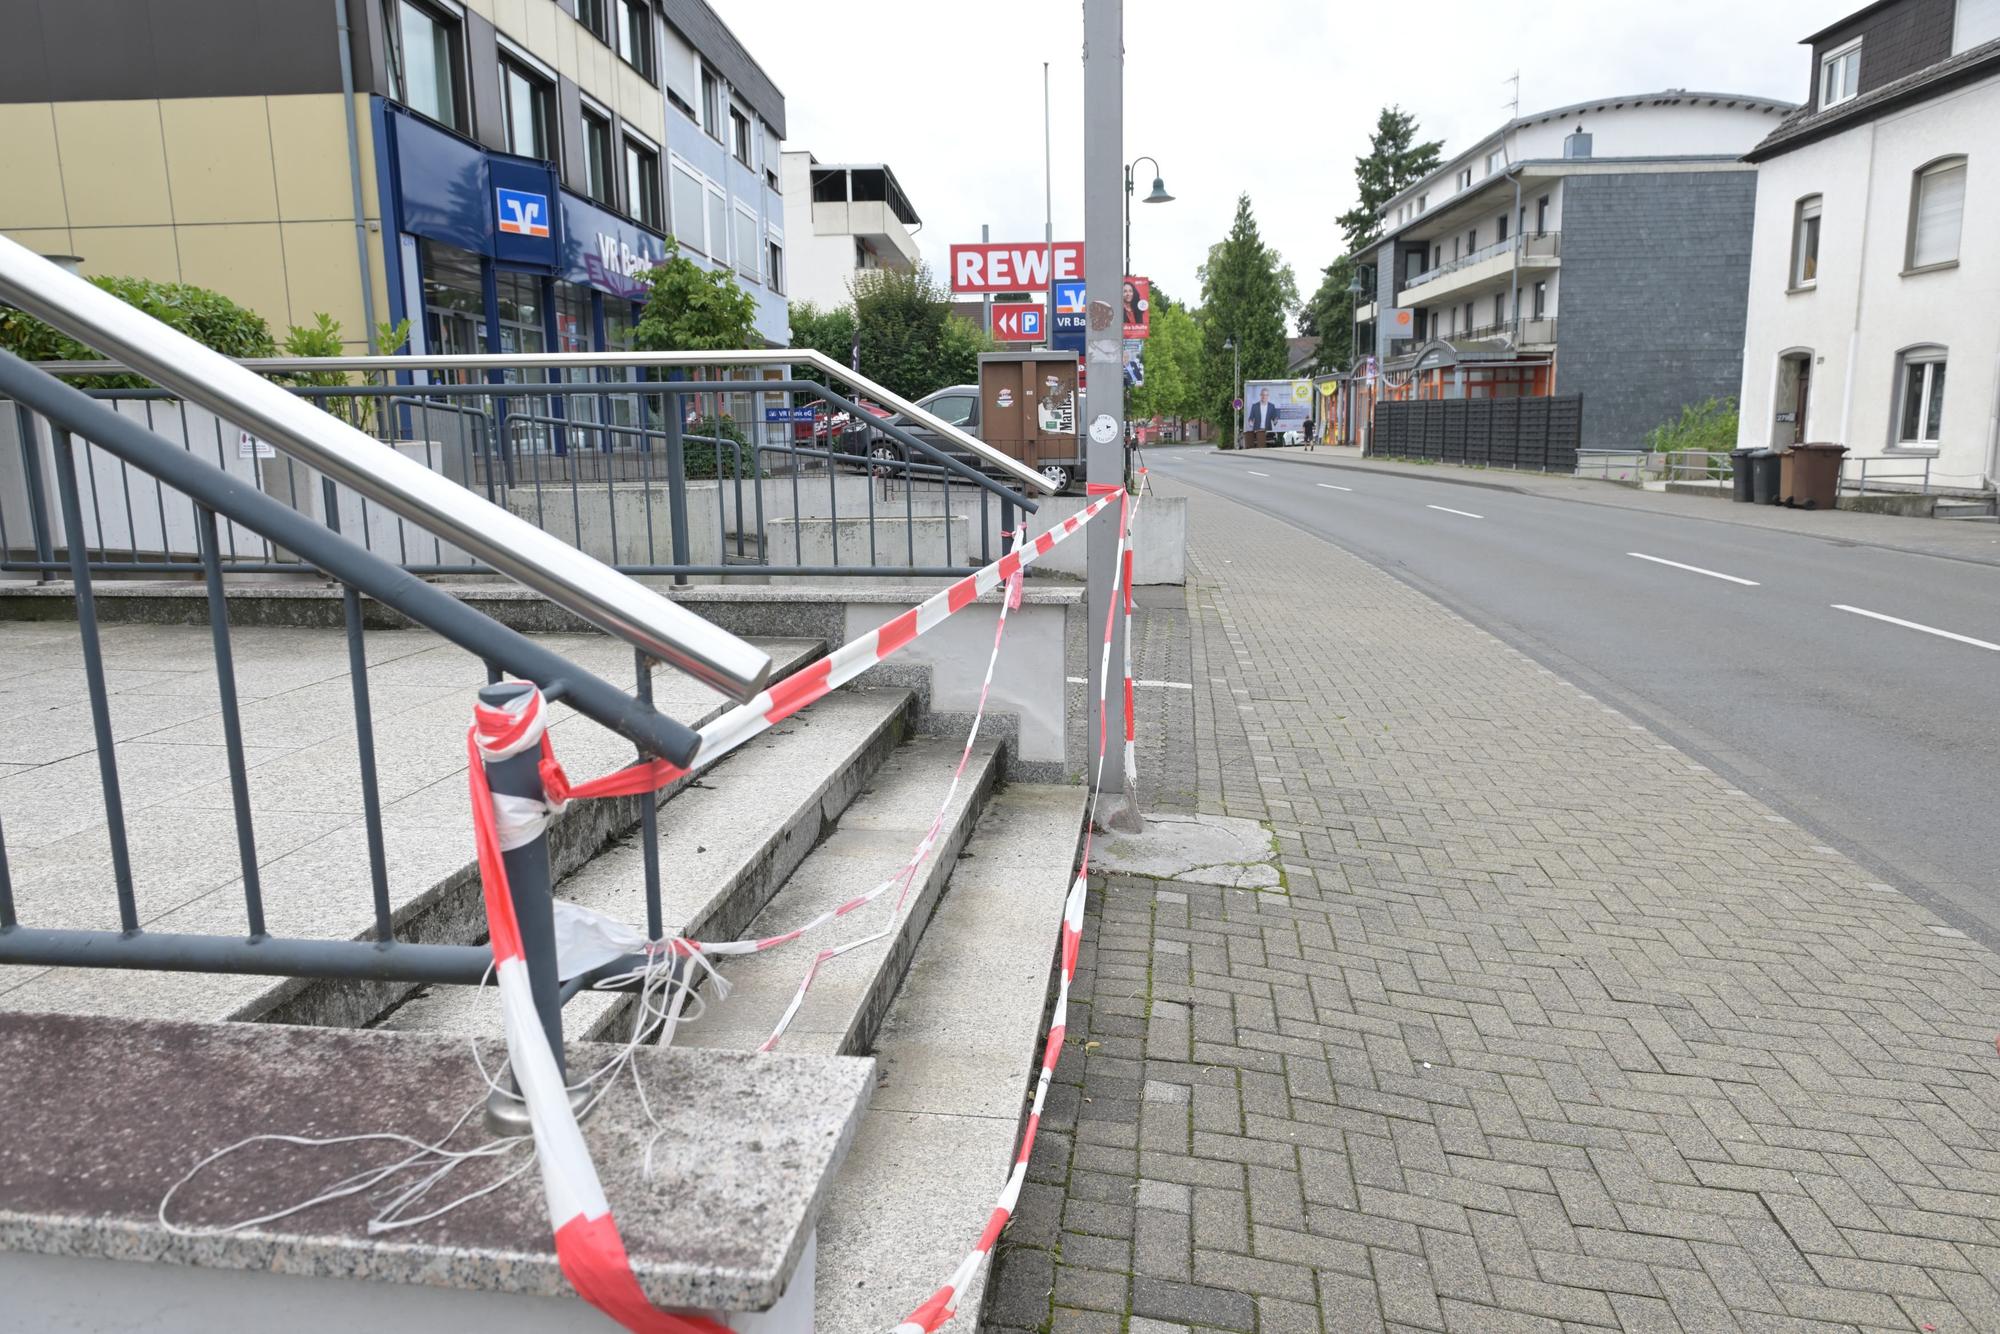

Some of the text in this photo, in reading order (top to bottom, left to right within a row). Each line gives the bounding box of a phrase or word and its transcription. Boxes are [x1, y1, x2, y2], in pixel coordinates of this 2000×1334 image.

[597, 232, 621, 275] VR
[957, 249, 1078, 286] REWE
[1024, 314, 1036, 331] P
[1057, 317, 1071, 327] VR
